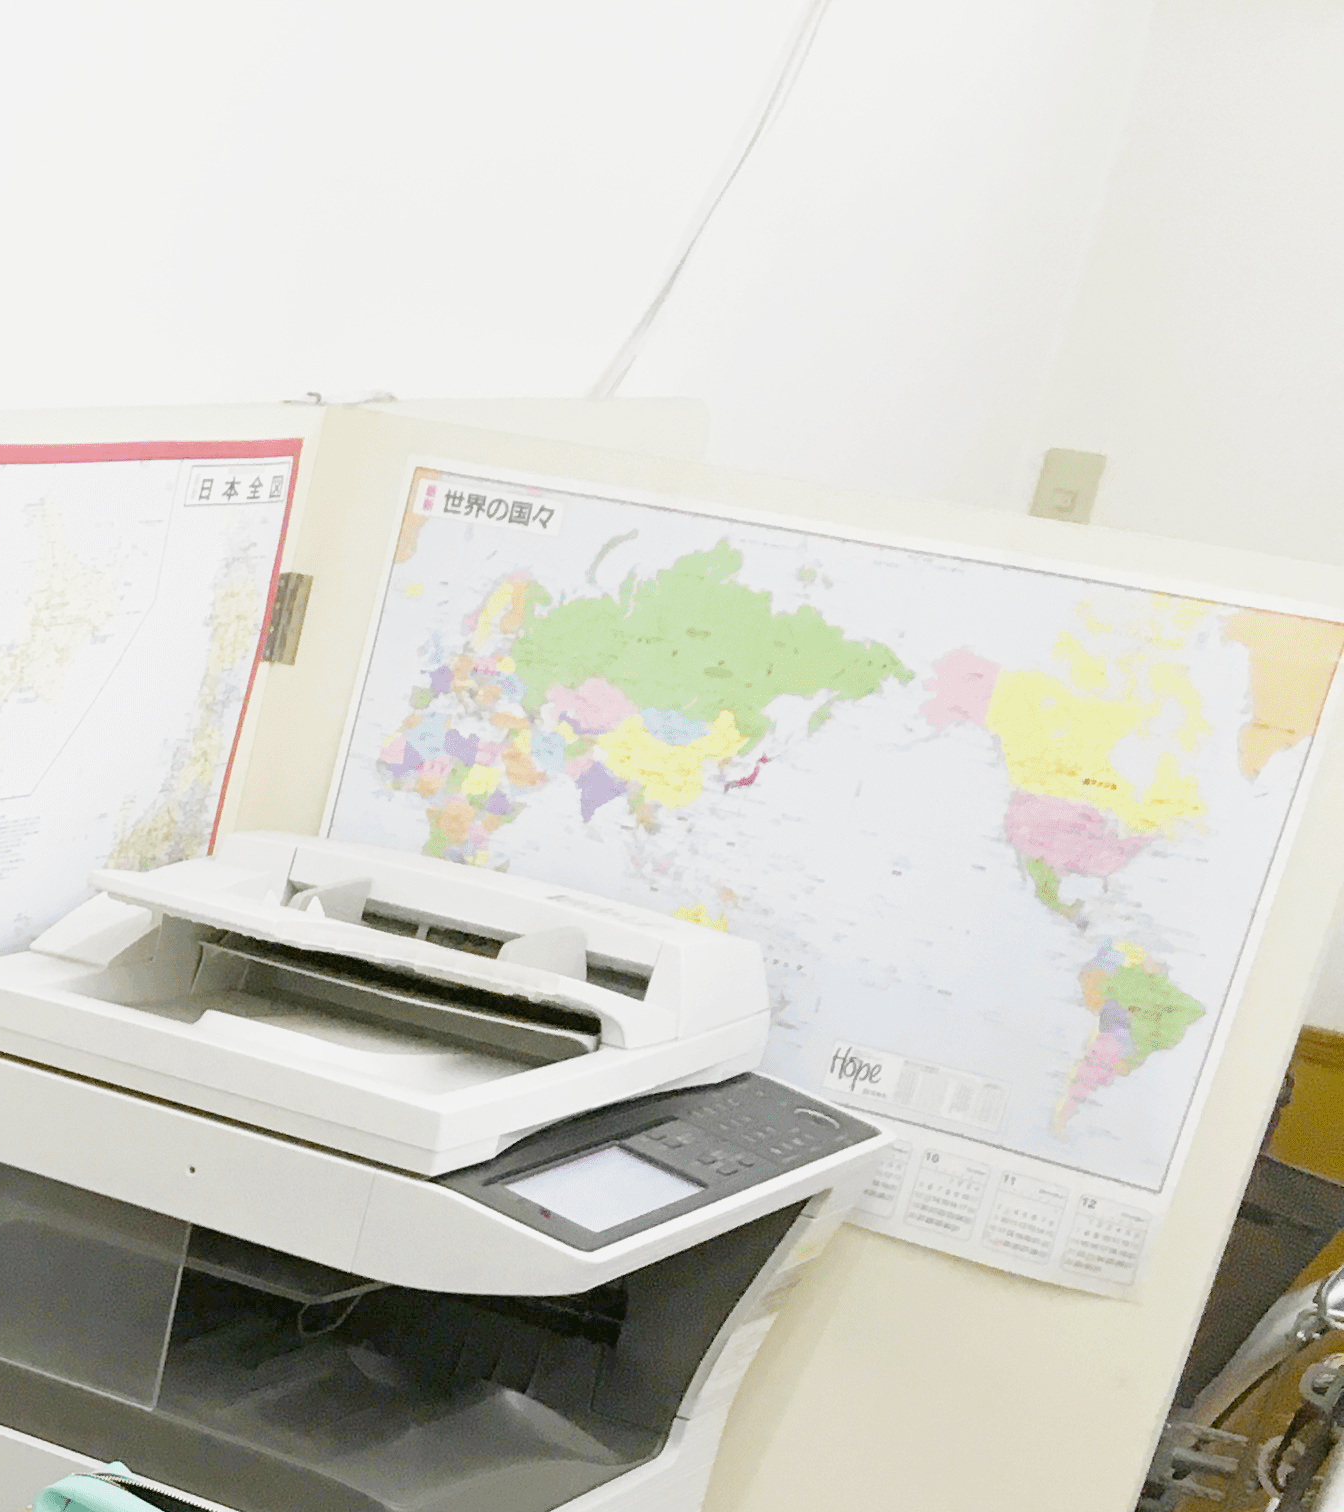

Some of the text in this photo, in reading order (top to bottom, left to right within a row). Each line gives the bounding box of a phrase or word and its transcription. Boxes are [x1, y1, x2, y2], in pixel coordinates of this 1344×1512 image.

[198, 475, 284, 501] 日本全図
[443, 489, 555, 529] 世界の国々
[830, 1046, 883, 1092] Hope
